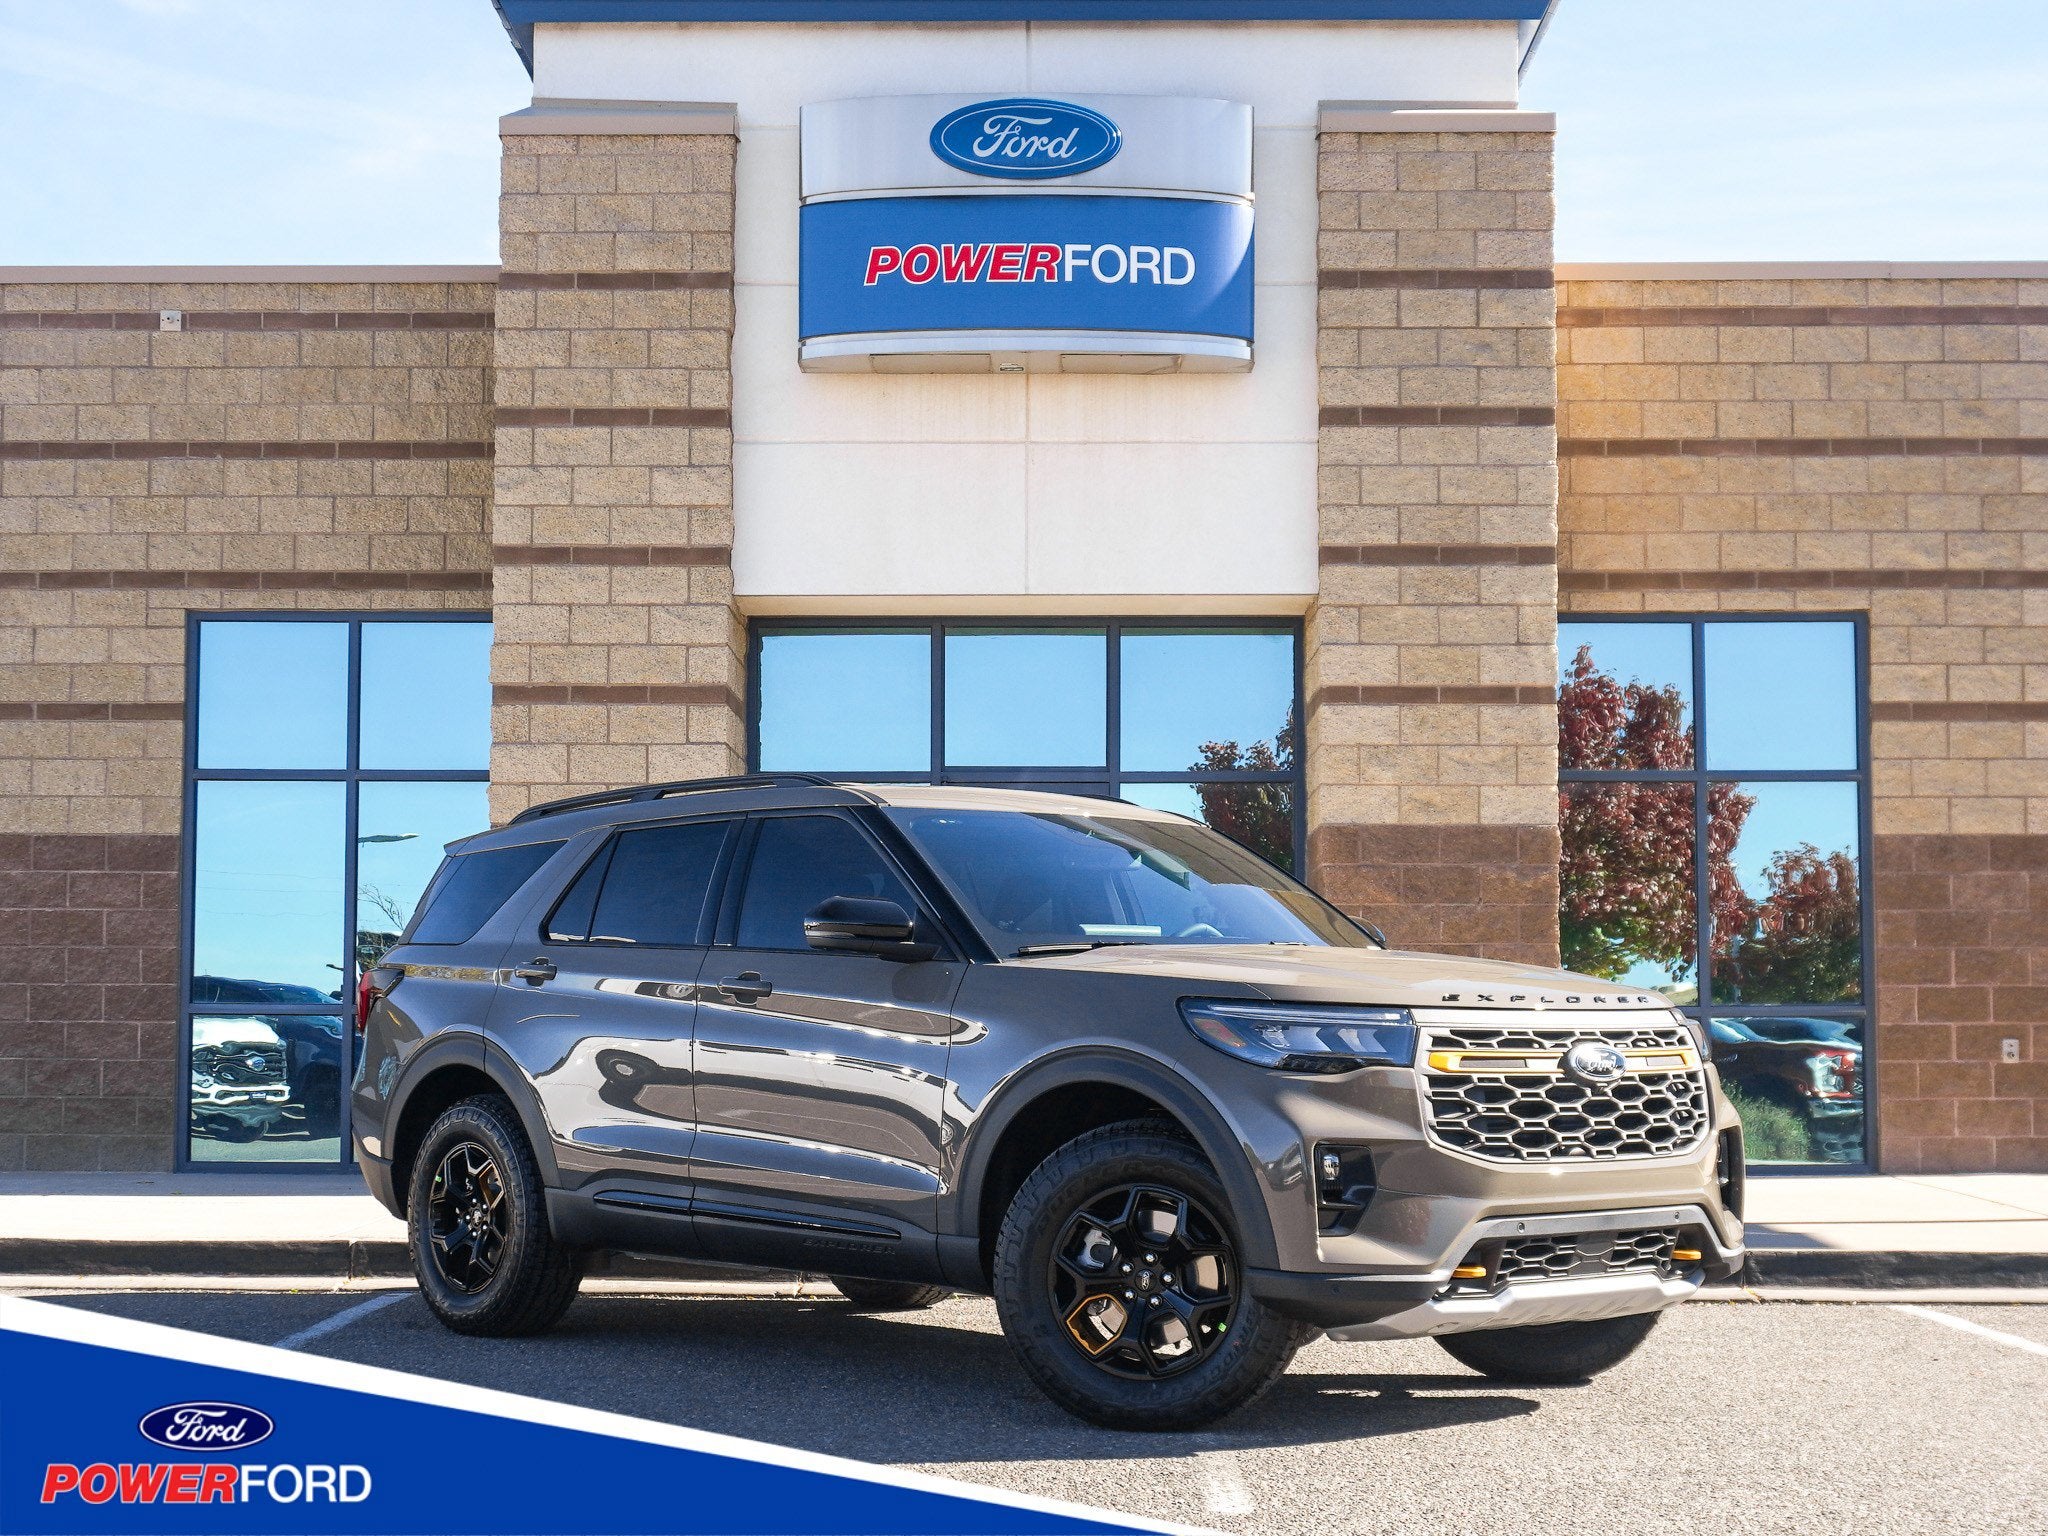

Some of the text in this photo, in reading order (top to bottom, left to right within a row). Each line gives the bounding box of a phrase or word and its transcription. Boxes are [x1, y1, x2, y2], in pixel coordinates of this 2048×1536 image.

[972, 114, 1080, 160] Ford
[863, 242, 1196, 286] POWERFORD
[1441, 993, 1650, 1005] EXPLORER
